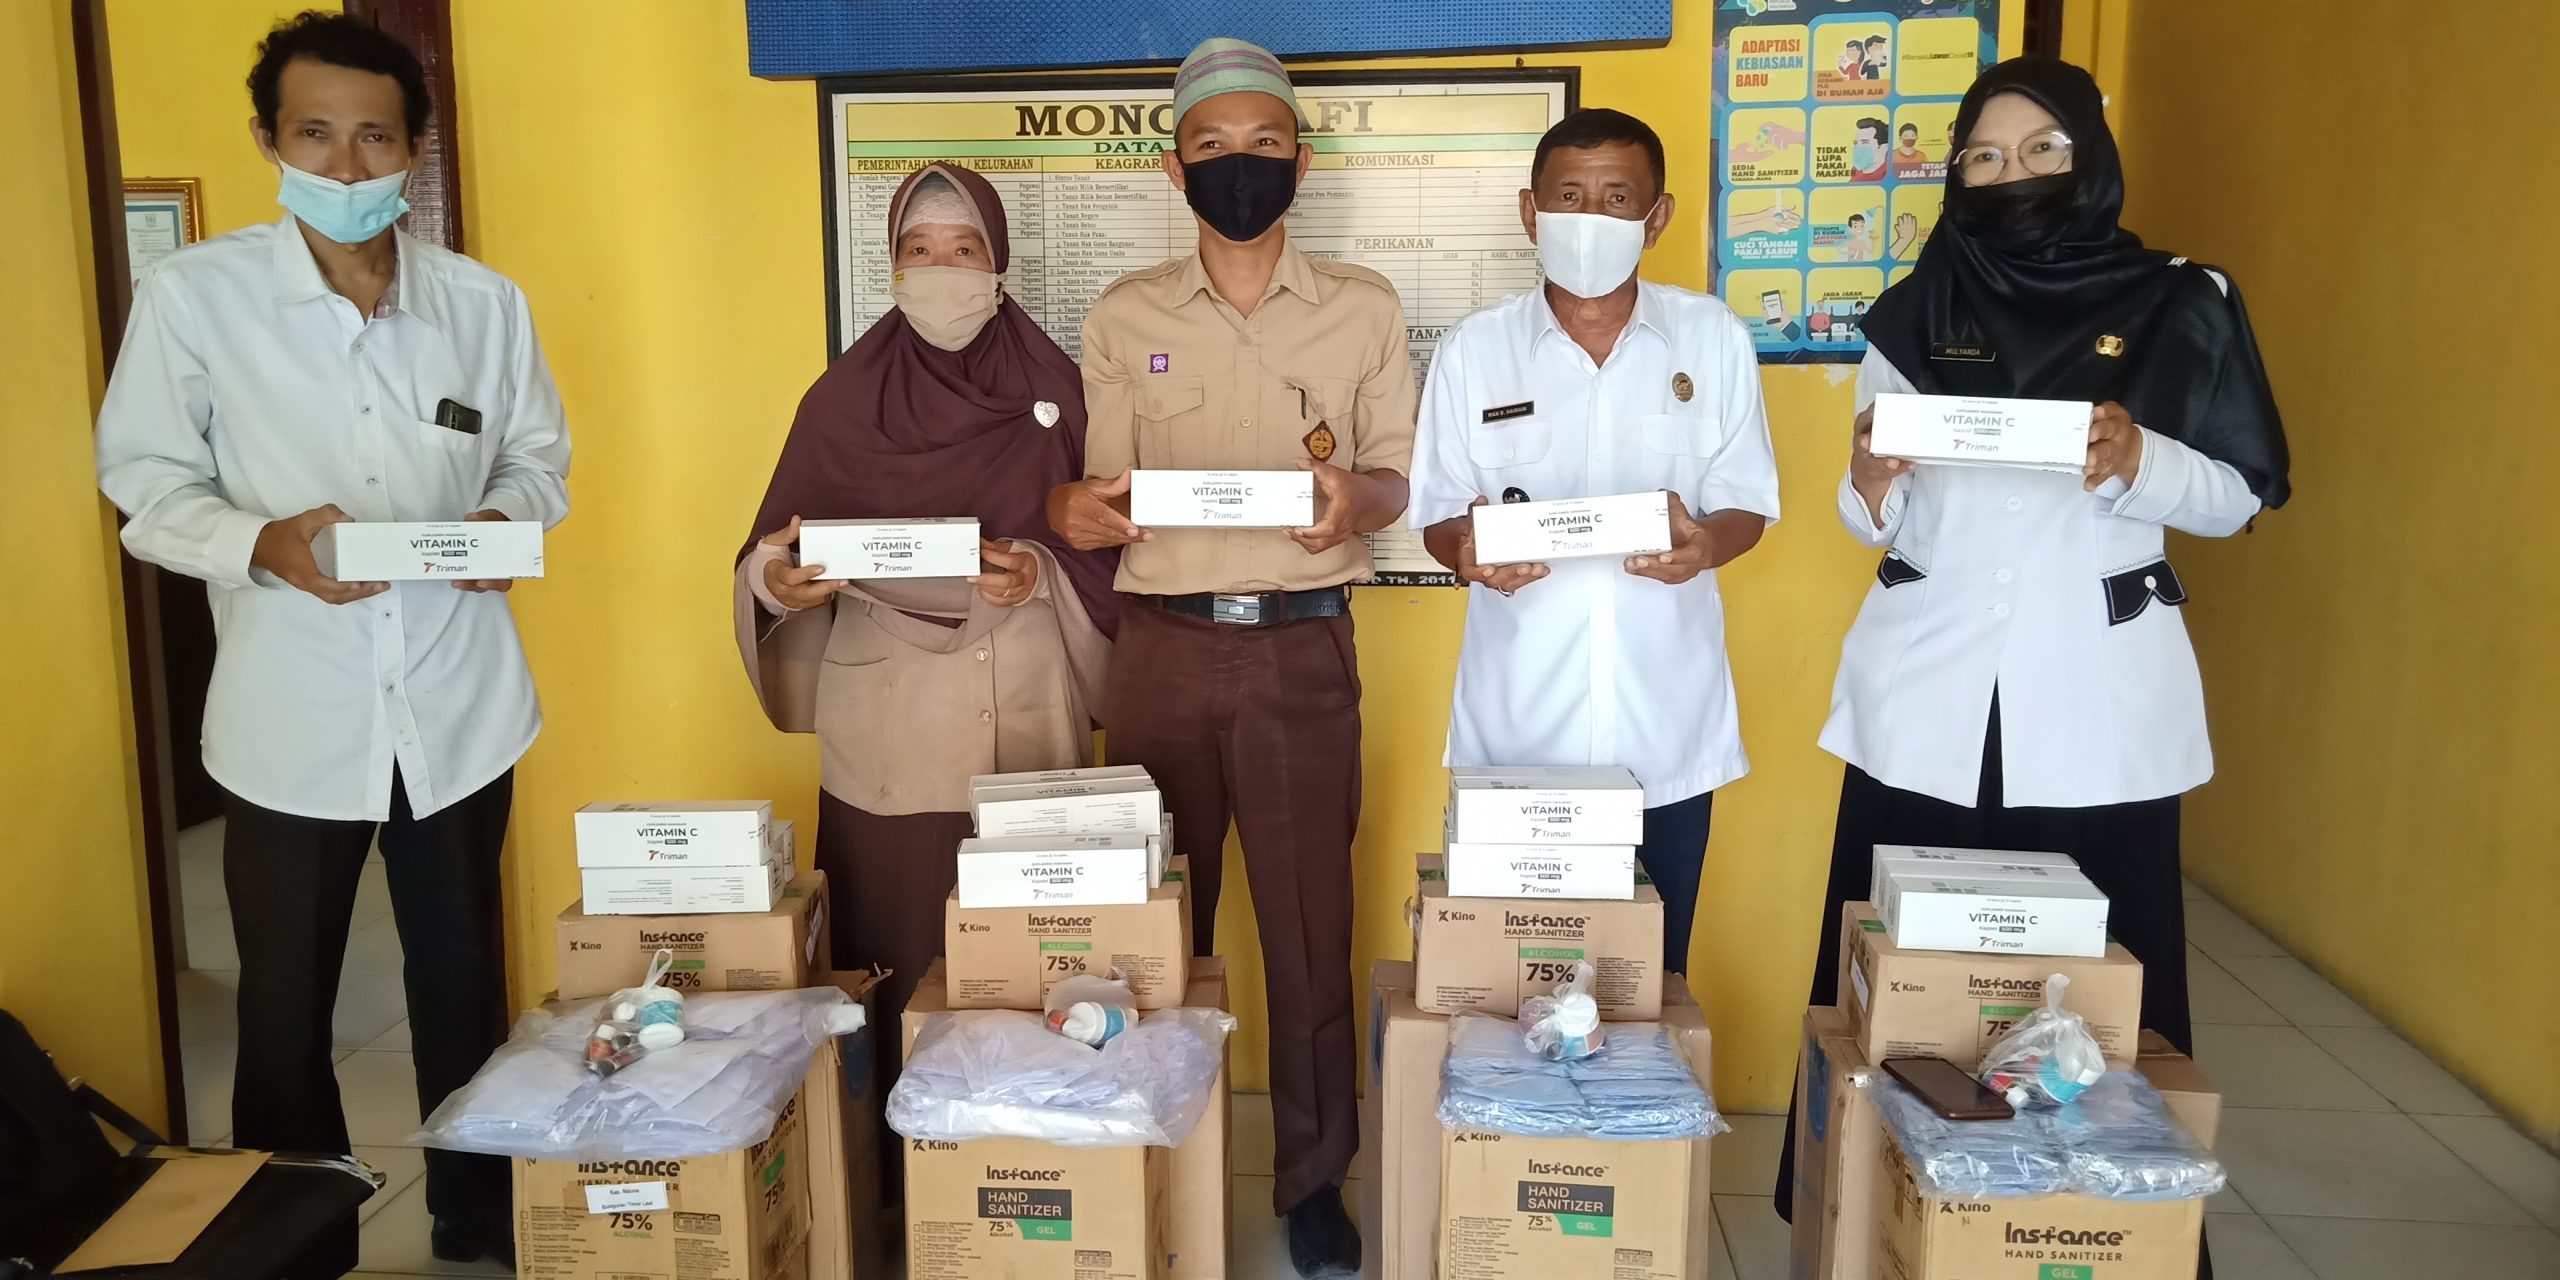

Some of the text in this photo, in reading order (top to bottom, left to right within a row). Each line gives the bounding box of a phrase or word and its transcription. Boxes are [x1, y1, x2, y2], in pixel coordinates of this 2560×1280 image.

[1741, 38, 1800, 54] ADAPTASI
[1736, 55, 1804, 71] KEBIASAAN
[1735, 74, 1769, 87] BARU
[1094, 142, 1164, 154] DATA
[1816, 147, 1847, 155] TIDAK
[1345, 154, 1434, 167] KOMUNIKASI
[1816, 154, 1842, 162] LUPA
[974, 159, 1034, 170] KELURAHAN
[1816, 162, 1846, 170] PAKAI
[1816, 169, 1856, 178] MASKER
[1898, 170, 1926, 178] JAGA
[1355, 238, 1434, 250] PERIKANAN
[1734, 240, 1798, 249] CUCI TANGAN
[1943, 414, 2016, 428] VITAMIN C
[1964, 442, 1999, 453] Triman
[1191, 487, 1254, 496] VITAMIN C
[1212, 511, 1243, 520] Triman
[1537, 513, 1603, 528] VITAMIN C
[410, 538, 479, 549] VITAMIN C
[862, 541, 923, 552] VITAMIN C
[435, 564, 469, 573] Triman
[884, 564, 913, 573] Triman
[1418, 575, 1456, 584] 2011
[1520, 805, 1583, 816] VITAMIN C
[636, 828, 698, 838] VITAMIN C
[1541, 829, 1571, 839] Triman
[658, 851, 688, 861] Triman
[1021, 866, 1084, 878] VITAMIN C
[1510, 861, 1573, 872] VITAMIN C
[1043, 891, 1074, 900] Triman
[1531, 885, 1561, 895] Triman
[1450, 911, 1476, 922] Kino
[1968, 912, 2039, 926] VITAMIN C
[969, 924, 991, 933] Kino
[1028, 927, 1092, 935] HAND SANITIZER
[1504, 928, 1585, 939] HAND SANITIZER
[580, 941, 602, 951] Kino
[640, 943, 705, 951] HAND SANITIZER
[1991, 939, 2024, 949] Triman
[1528, 949, 1577, 959] ALCOHOL
[1046, 955, 1087, 972] 75%
[1526, 962, 1575, 983] 75%
[662, 972, 701, 989] 75%
[1902, 983, 1926, 994] Kino
[1968, 990, 2041, 1000] HAND SANITIZER
[1470, 1131, 1501, 1143] Kino
[928, 1139, 959, 1152] Kino
[988, 1191, 1028, 1204] HAND
[1528, 1185, 1569, 1199] HAND
[987, 1204, 1063, 1218] SANITIZER
[1527, 1198, 1604, 1214] SANITIZER
[1957, 1202, 1992, 1214] Kino
[608, 1212, 654, 1231] 75%
[1576, 1221, 1597, 1232] GEL
[612, 1230, 655, 1240] ALCOHOL
[1036, 1225, 1056, 1236] GEL
[2005, 1249, 2044, 1260] HAND
[2050, 1250, 2123, 1262] SANITIZER
[2051, 1267, 2079, 1280] GEL
